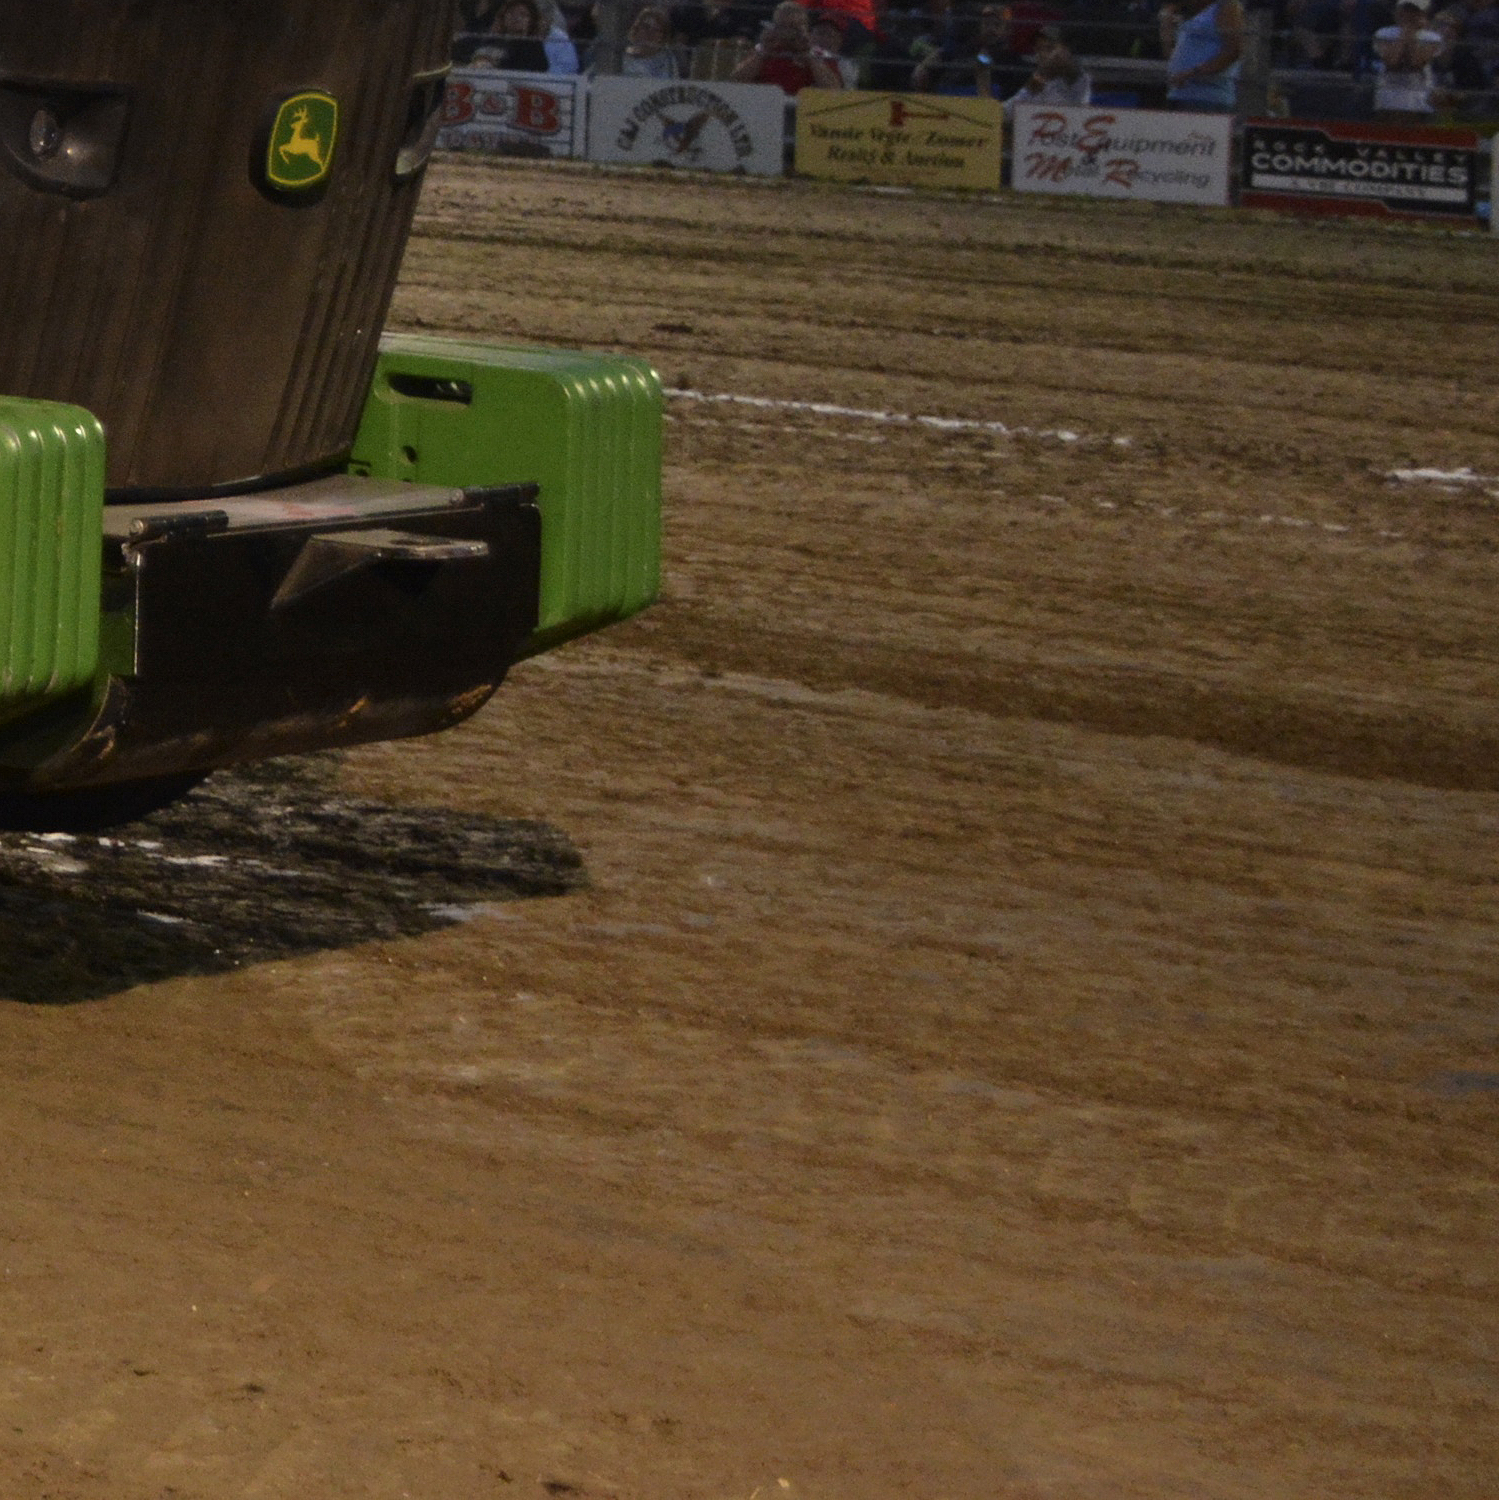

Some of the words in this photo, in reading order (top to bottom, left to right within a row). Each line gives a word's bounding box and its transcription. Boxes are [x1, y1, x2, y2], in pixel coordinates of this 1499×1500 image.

[1252, 139, 1326, 155] ROCK
[1355, 147, 1468, 164] VALLEY
[1250, 152, 1470, 185] COMMODITIES
